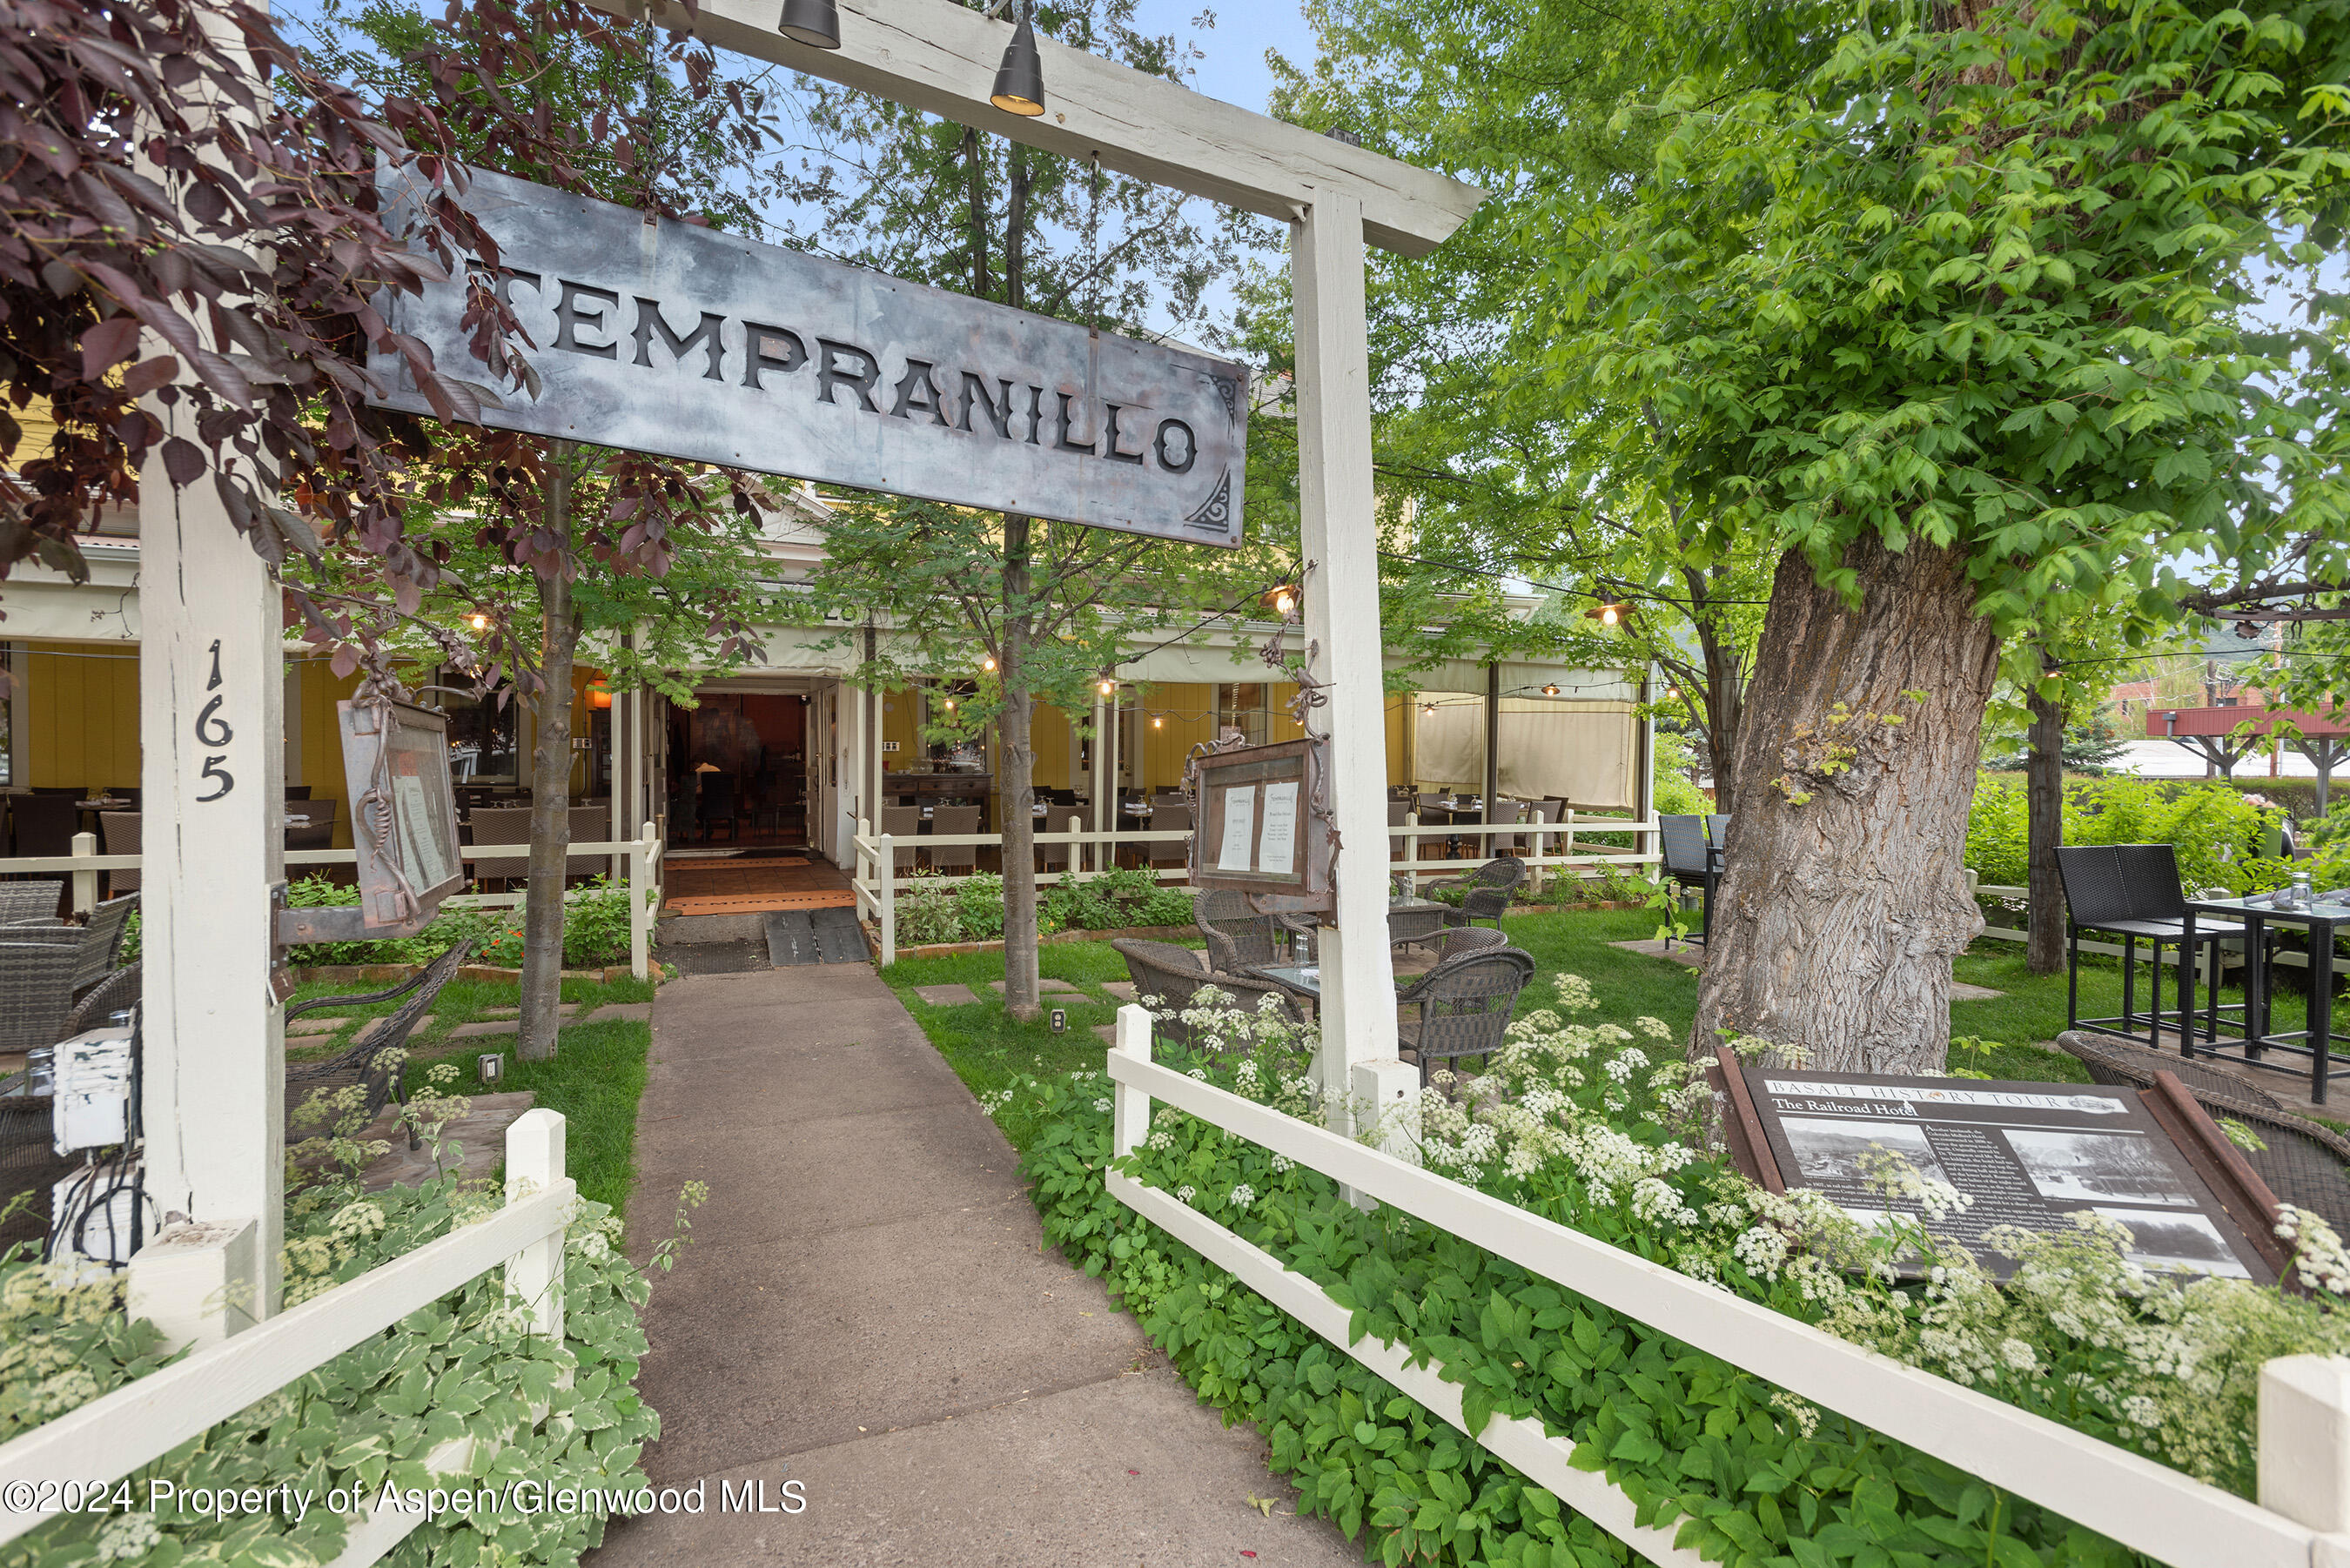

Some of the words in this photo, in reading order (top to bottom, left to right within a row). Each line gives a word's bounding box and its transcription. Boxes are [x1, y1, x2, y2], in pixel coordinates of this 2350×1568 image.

[466, 258, 1198, 474] TEMPRANILLO
[195, 639, 234, 802] 165
[1772, 1082, 1857, 1096] BASALT
[1871, 1087, 1977, 1103] HISTORY
[1988, 1093, 2062, 1108] TOUR
[1772, 1098, 1804, 1110] The
[1804, 1100, 1872, 1115] Railroad
